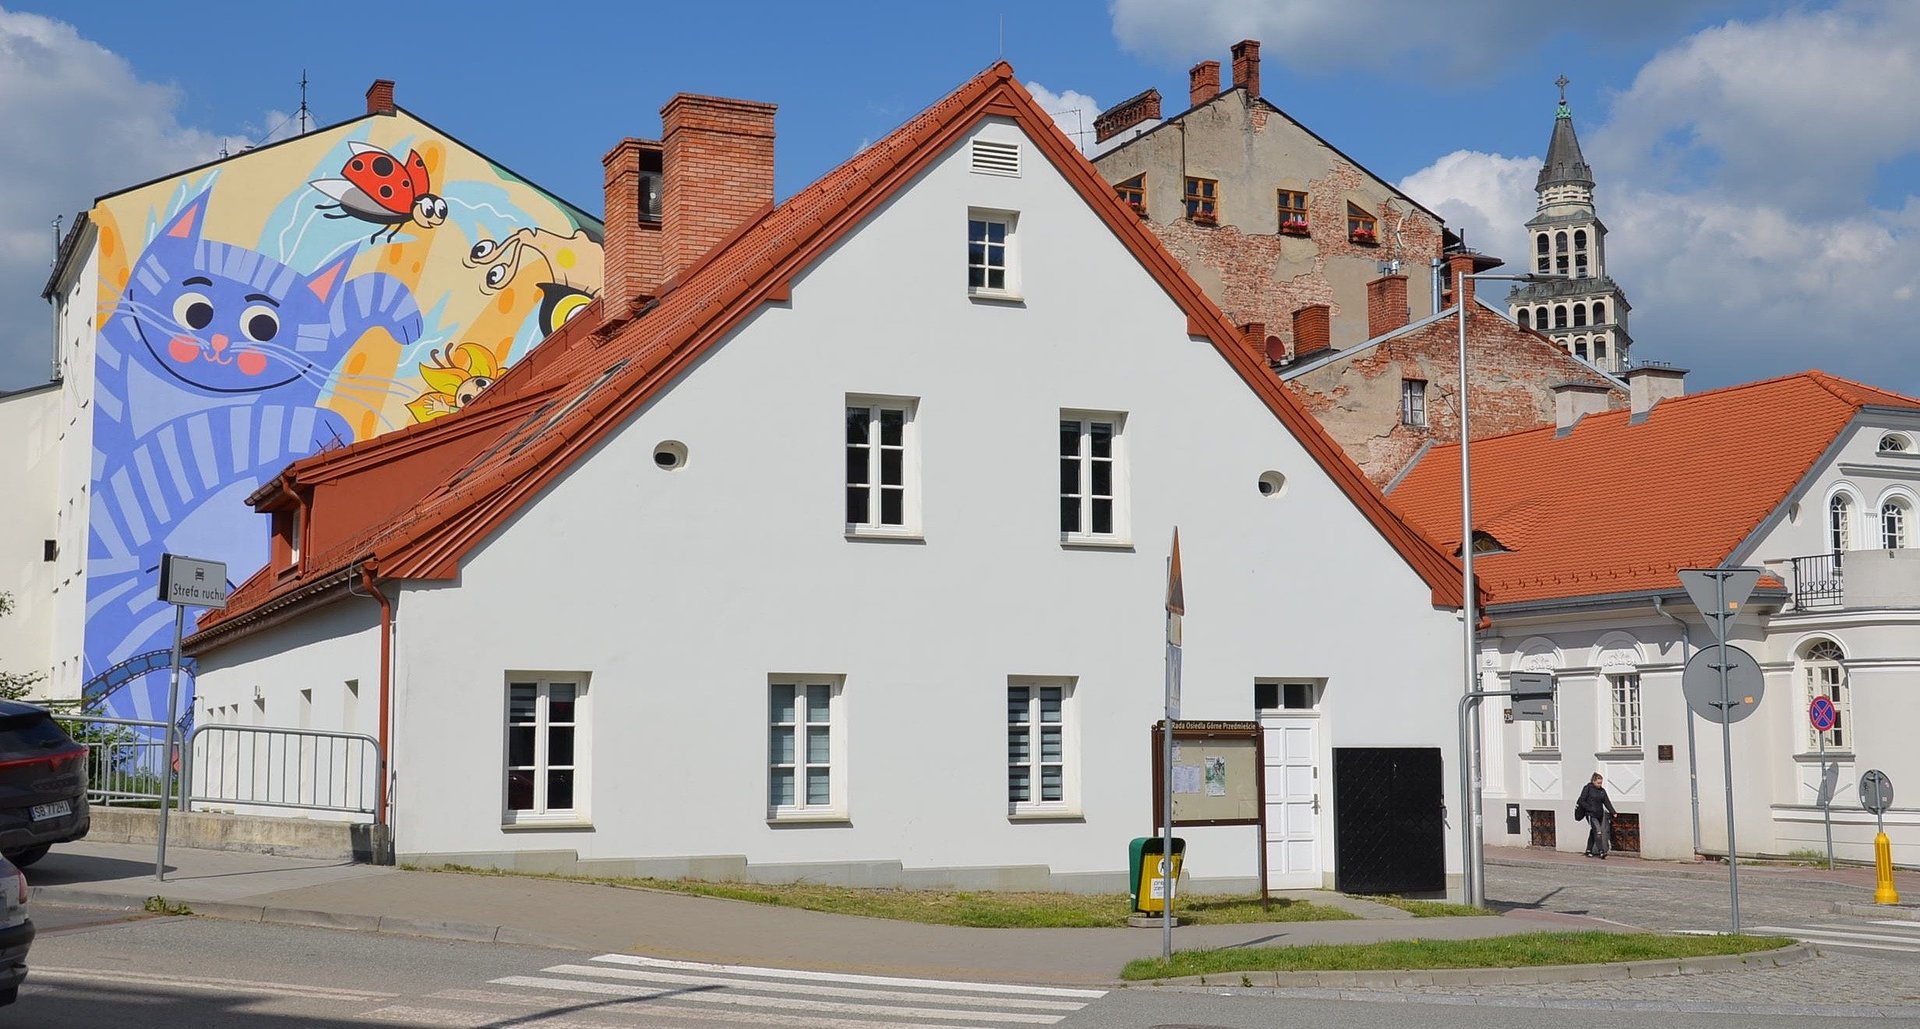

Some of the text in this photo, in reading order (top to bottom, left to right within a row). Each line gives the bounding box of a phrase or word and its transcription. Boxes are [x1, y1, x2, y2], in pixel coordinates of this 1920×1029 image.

[173, 583, 225, 601] Strefa ruchu
[1172, 721, 1256, 730] Rada Osiedla Górne Przedmieście
